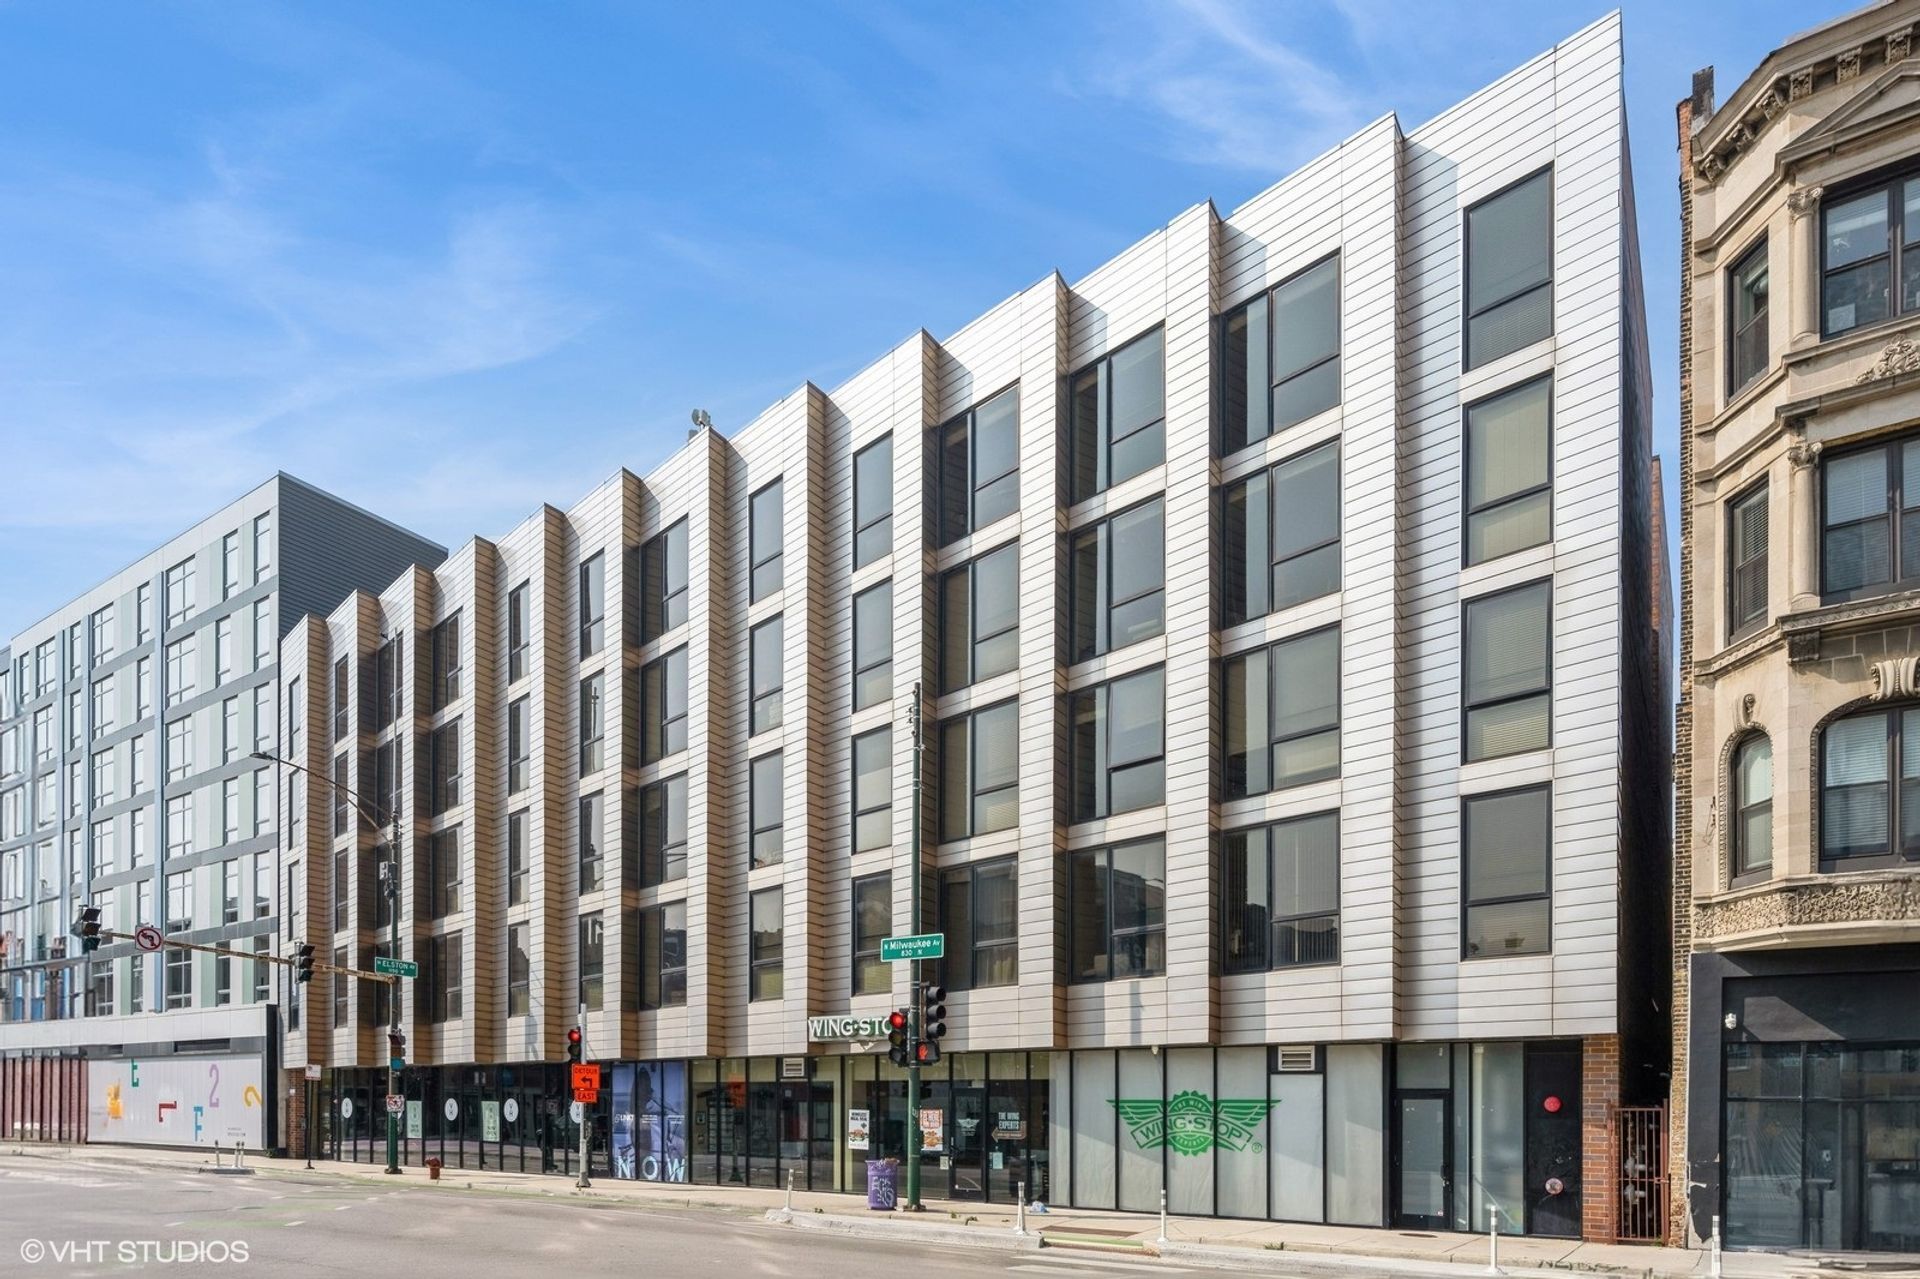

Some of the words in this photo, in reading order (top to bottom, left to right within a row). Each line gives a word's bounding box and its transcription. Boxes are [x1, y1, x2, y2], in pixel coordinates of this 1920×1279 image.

[890, 939, 931, 950] Milwaukee
[382, 960, 408, 970] ELSTON
[574, 1066, 598, 1075] DETOUR
[577, 1092, 595, 1100] EAST
[998, 1120, 1020, 1130] EXPERTS
